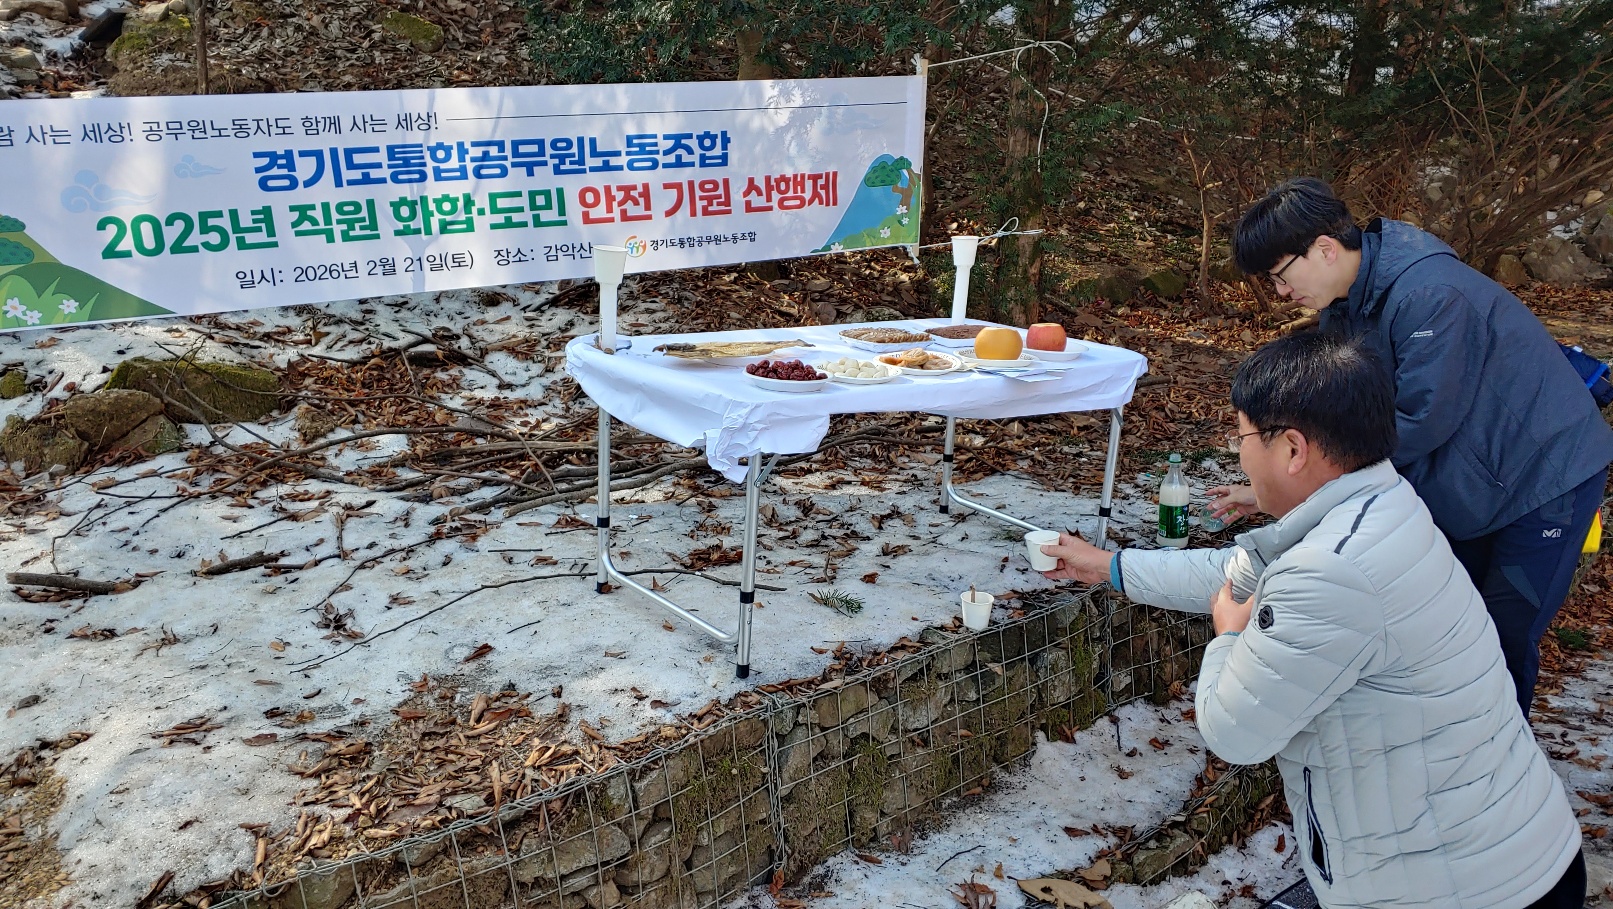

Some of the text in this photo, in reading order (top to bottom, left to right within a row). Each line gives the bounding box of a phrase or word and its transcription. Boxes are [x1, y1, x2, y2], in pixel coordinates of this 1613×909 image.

[24, 124, 72, 146] 사는
[80, 121, 134, 144] 세상!
[141, 116, 295, 142] 공무원노동자도
[300, 114, 342, 136] 함께
[349, 113, 388, 134] 사는
[394, 111, 439, 132] 세상!
[251, 129, 732, 193] 경기도통합공무원노동조합
[95, 170, 839, 261] 2025년 직원 화합·도민 안전 기원 산행제
[235, 240, 594, 290] 일시: 2026년 2월 21일(토) 장소: 감악산
[649, 230, 758, 252] 경기도통합공무원노동조합
